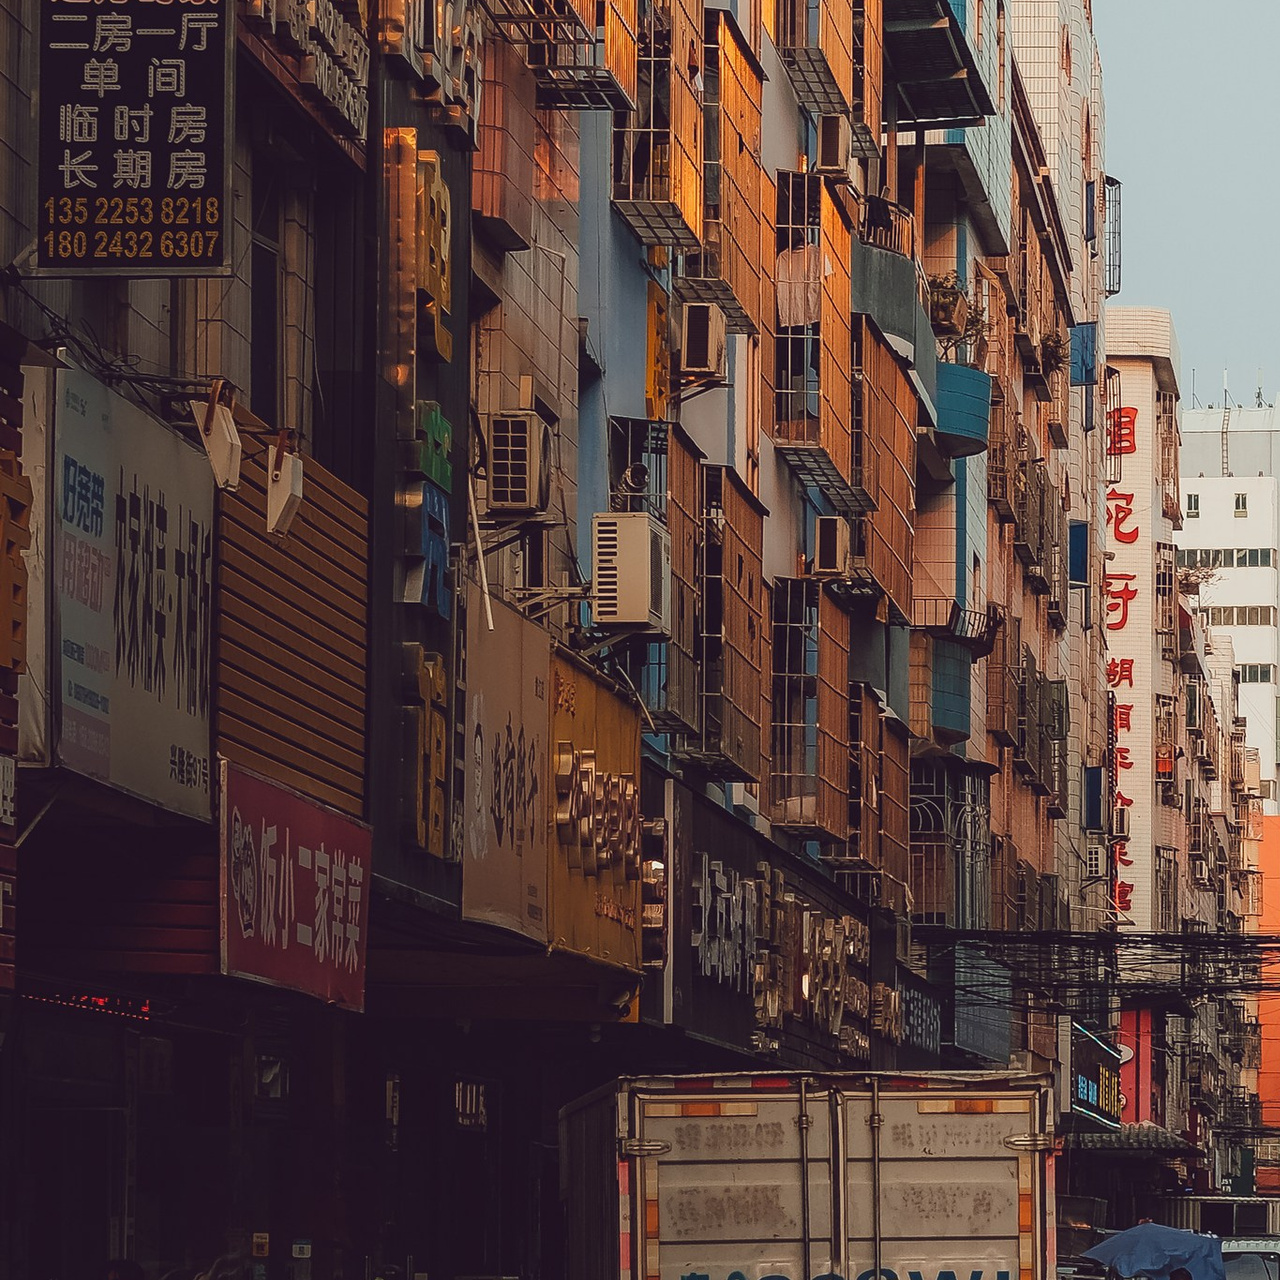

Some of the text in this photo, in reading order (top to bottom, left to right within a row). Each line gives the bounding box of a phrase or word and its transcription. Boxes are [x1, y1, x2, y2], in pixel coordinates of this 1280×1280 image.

[49, 12, 219, 52] 二房一厅
[59, 103, 208, 144] 临时房
[58, 149, 208, 190] 长期房
[44, 196, 219, 225] 135 2253 8218
[44, 230, 220, 259] 180 2432 6307
[62, 453, 105, 539] 好宽带
[168, 742, 209, 795] 兴隆街97号
